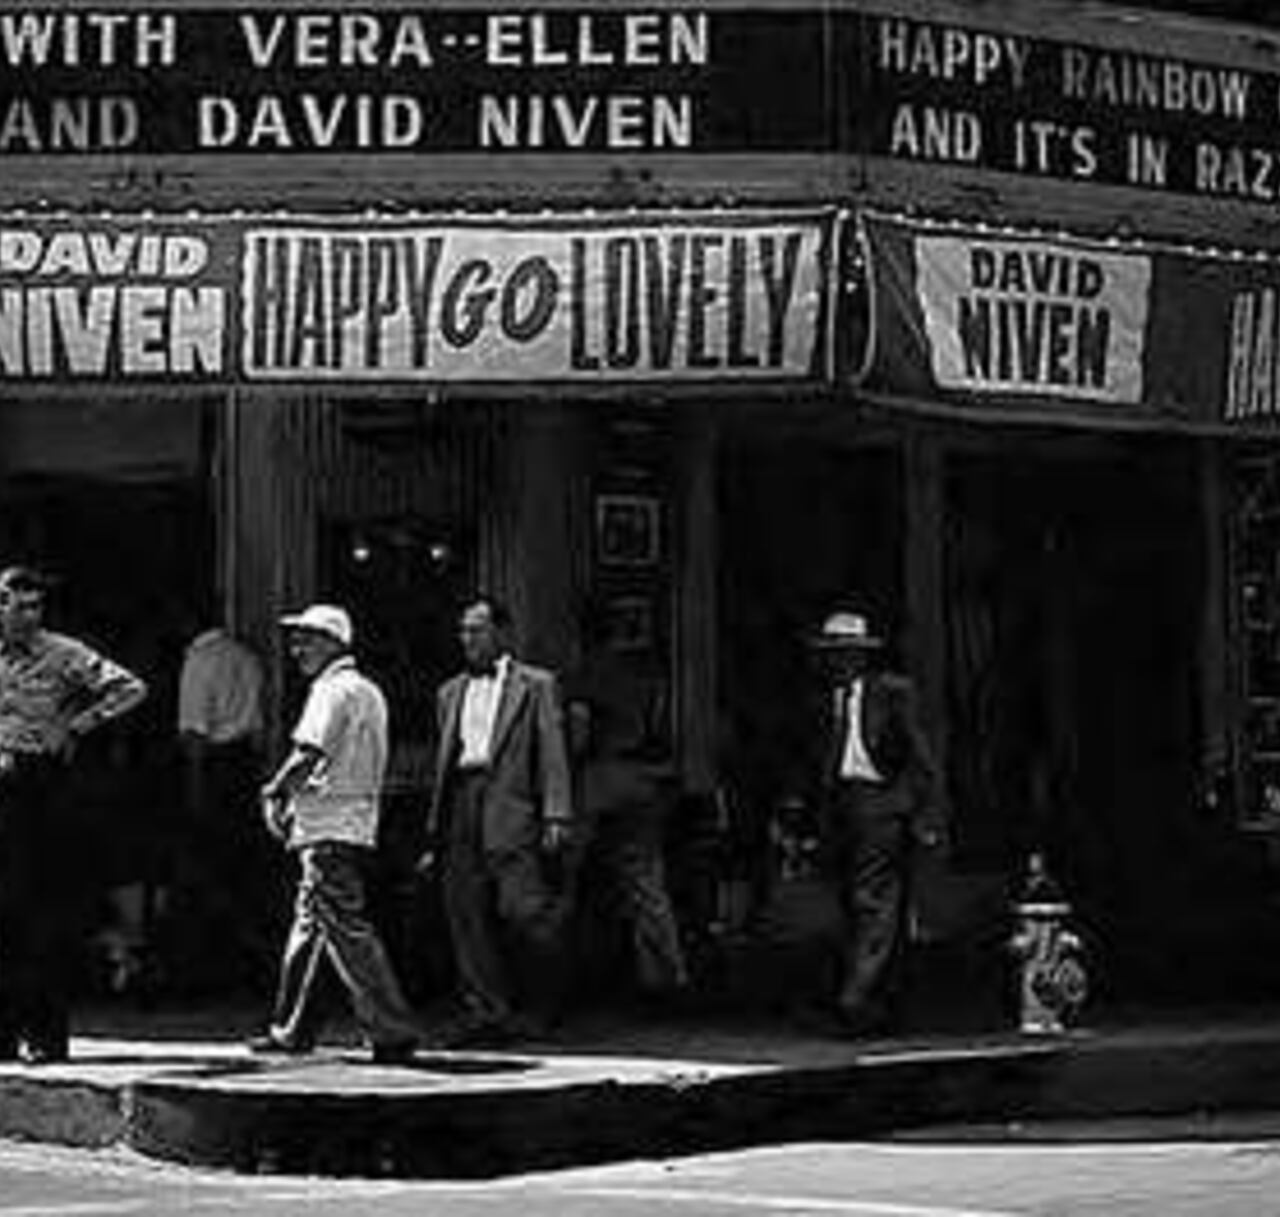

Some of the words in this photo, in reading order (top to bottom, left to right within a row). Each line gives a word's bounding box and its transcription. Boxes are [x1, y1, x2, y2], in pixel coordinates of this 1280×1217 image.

[0, 14, 177, 68] WITH
[878, 20, 1029, 86] HAPPY
[1063, 46, 1250, 120] RAINBOW
[0, 96, 138, 151] AND
[199, 96, 423, 151] DAVID
[478, 96, 695, 151] NIVEN
[890, 104, 984, 162] AND
[1015, 117, 1098, 177] IT'S
[1126, 132, 1168, 186] IN
[247, 236, 445, 370] HAPPY
[442, 258, 558, 348] GO
[568, 236, 806, 374] LOVELY
[970, 248, 1106, 300] DAVID
[958, 296, 1116, 389] NIVEN
